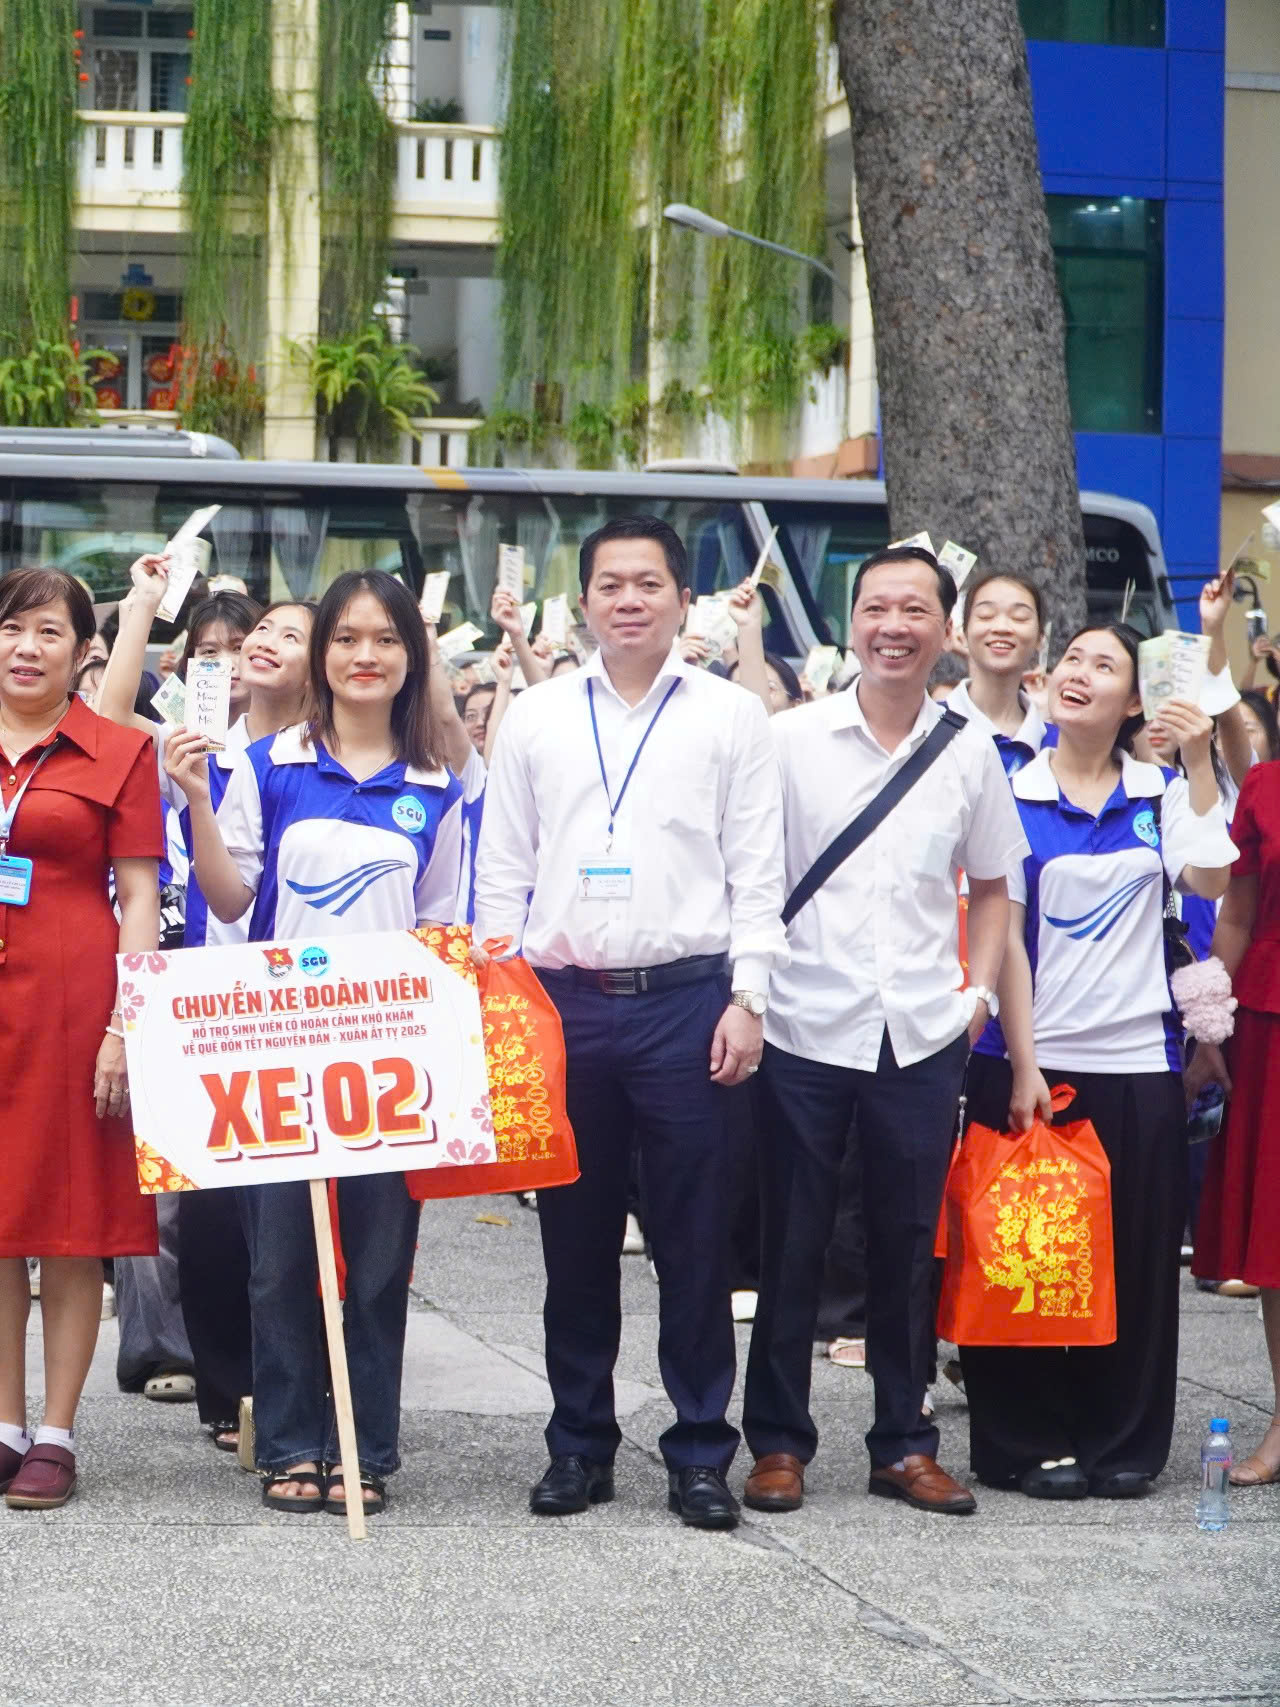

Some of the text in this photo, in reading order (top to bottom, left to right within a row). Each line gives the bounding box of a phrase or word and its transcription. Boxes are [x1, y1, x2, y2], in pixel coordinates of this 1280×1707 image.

[396, 805, 423, 822] SGU
[301, 956, 328, 967] SGU
[172, 973, 429, 1020] CHUYẾN XE ĐOÀN VIÊN
[192, 1009, 414, 1039] HỖ TRỢ SINH VIÊN CÓ HOÀN CẢNH KHÓ KHĂN
[182, 1040, 196, 1055] VỀ
[198, 1040, 217, 1055] QUÊ
[220, 1039, 242, 1052] ĐÓN
[245, 1034, 262, 1050] TẾT
[265, 1032, 306, 1048] NGUYÊN
[309, 1031, 331, 1044] ĐÁN
[340, 1027, 368, 1041] XUÂN
[370, 1024, 383, 1039] ẤT
[385, 1027, 398, 1040] TỴ
[401, 1025, 427, 1037] 2025
[200, 1057, 424, 1150] XE 02
